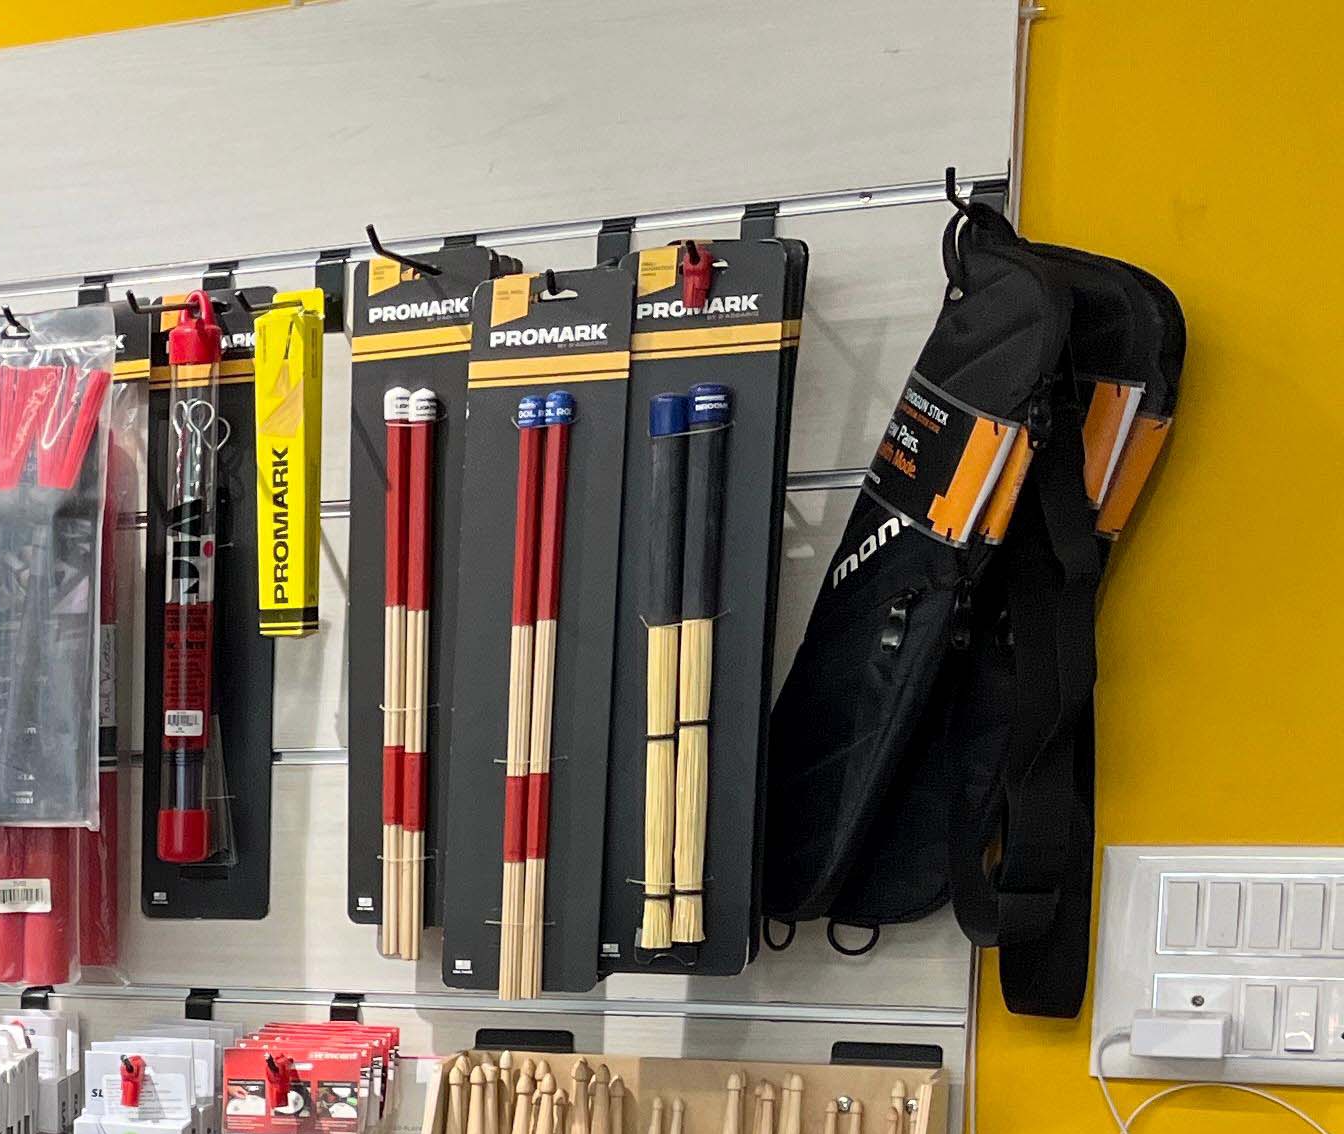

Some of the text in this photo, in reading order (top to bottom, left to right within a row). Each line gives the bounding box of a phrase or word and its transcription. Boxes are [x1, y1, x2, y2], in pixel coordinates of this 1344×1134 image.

[368, 297, 470, 324] PROMARK
[489, 323, 607, 348] PROMARK
[928, 404, 949, 426] STICK
[273, 446, 290, 605] PROMARK
[833, 516, 912, 589] mon
